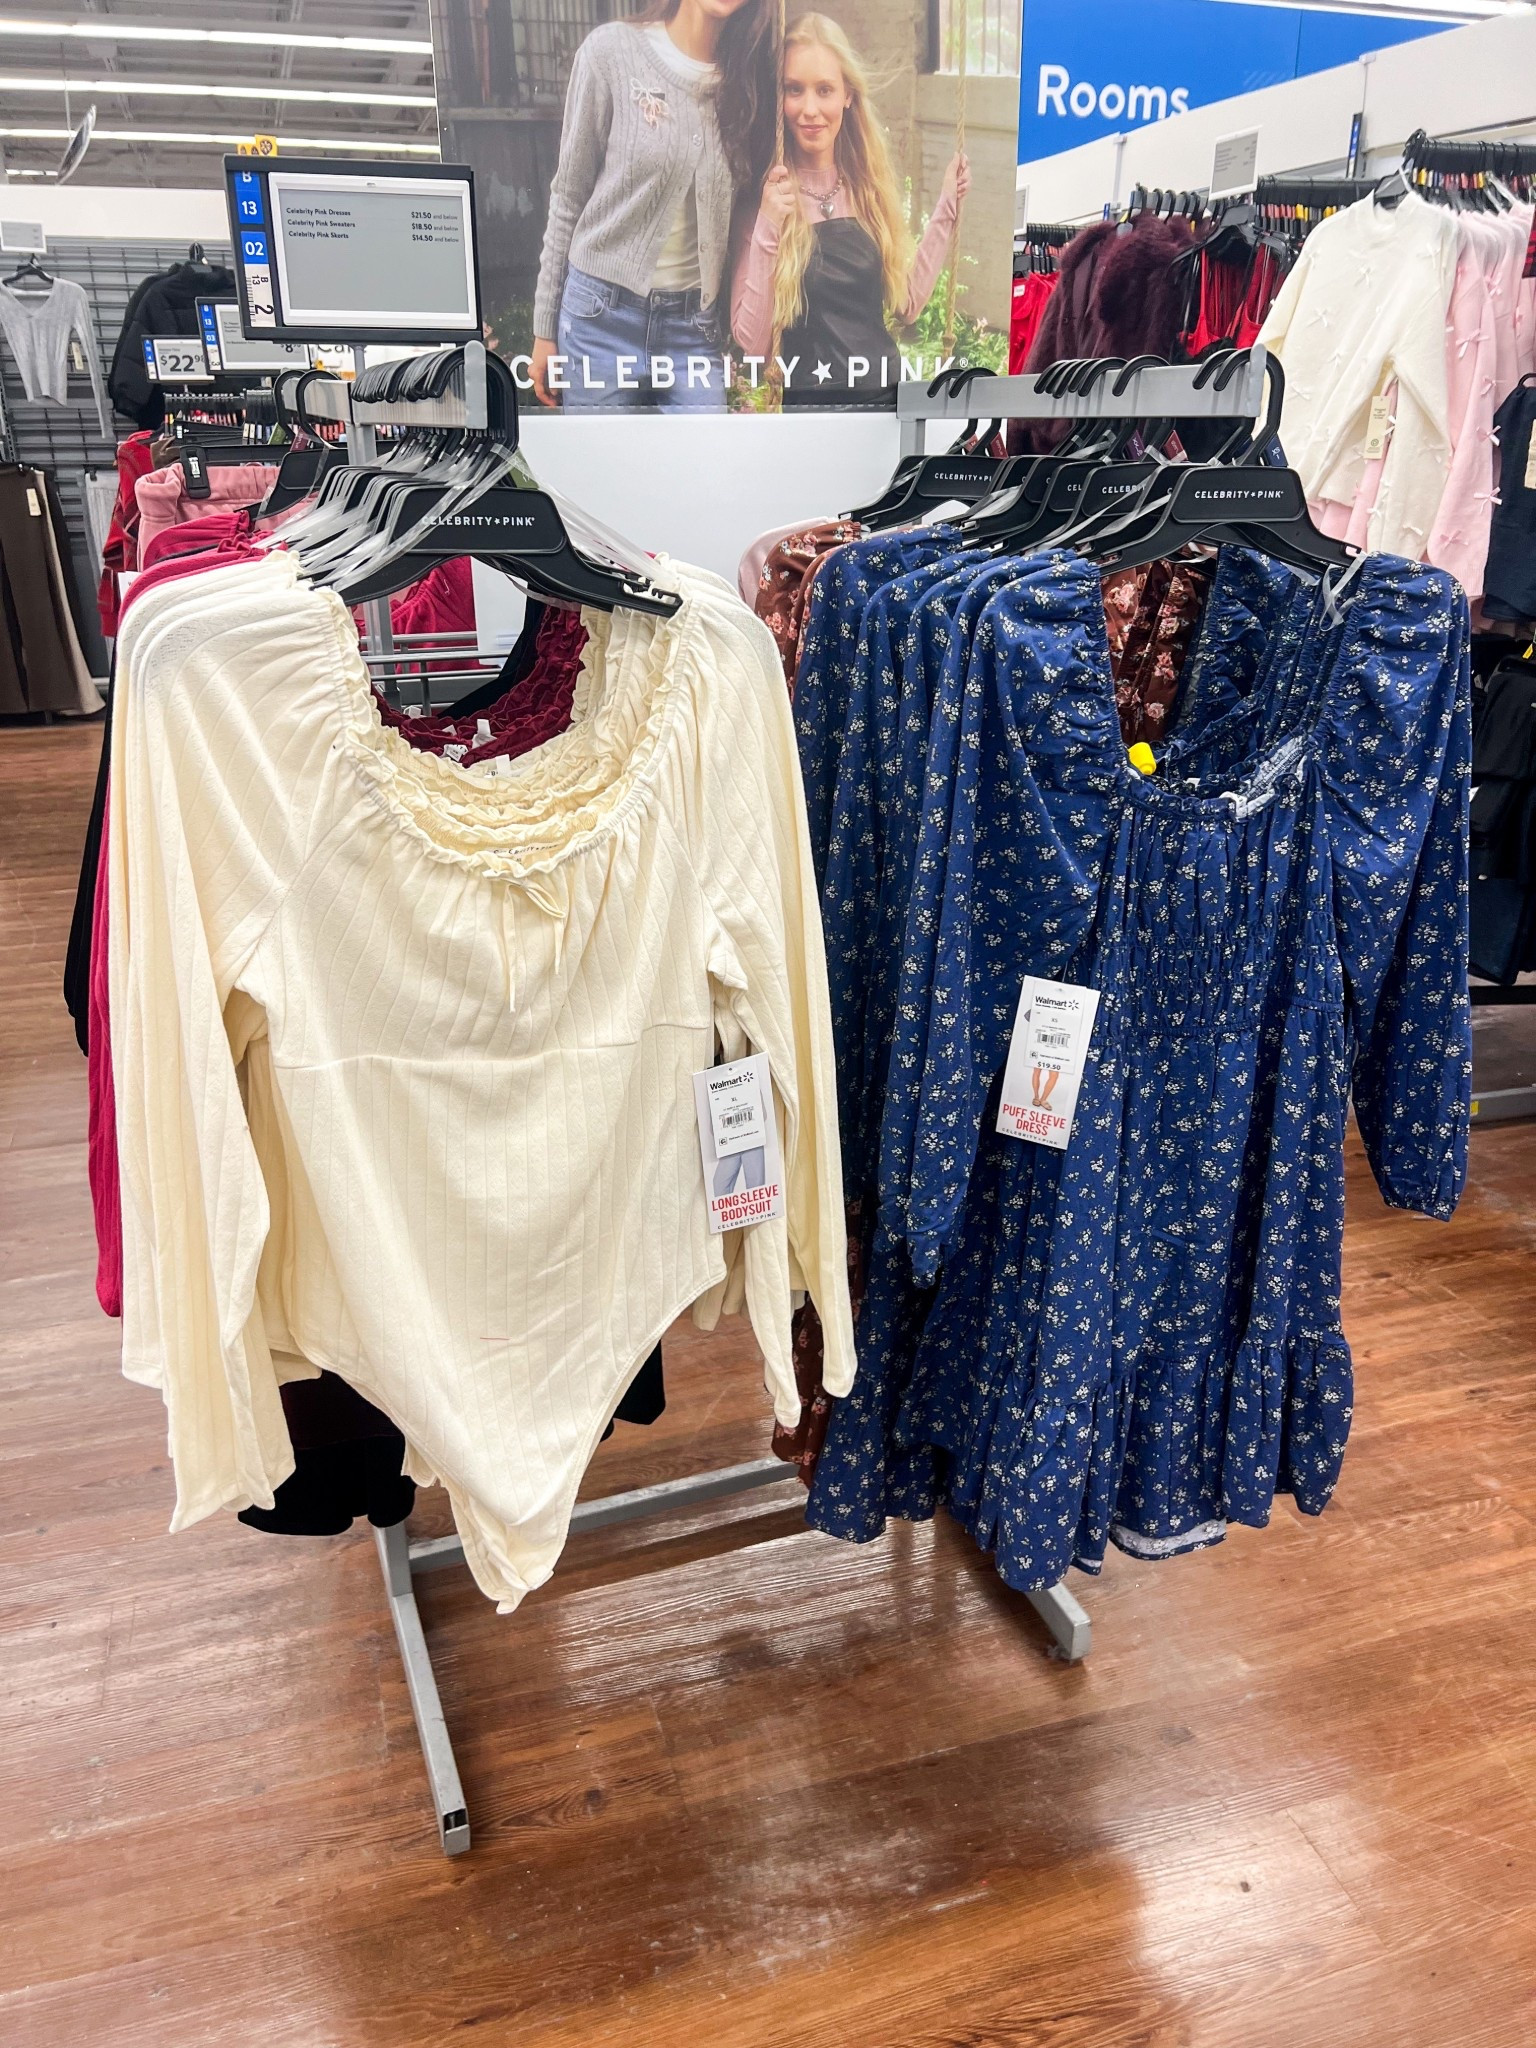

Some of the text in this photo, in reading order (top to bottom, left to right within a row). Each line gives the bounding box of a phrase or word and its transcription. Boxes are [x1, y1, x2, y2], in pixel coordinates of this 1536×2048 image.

[1037, 63, 1190, 120] Rooms
[241, 200, 258, 216] 13
[286, 207, 313, 216] Celebrity
[411, 211, 432, 219] $21.50
[287, 218, 356, 228] Celebrity Pink Sweaters
[412, 222, 433, 231] $18.50
[288, 230, 315, 240] Celebrity
[245, 241, 264, 256] 02
[254, 304, 275, 315] 2
[510, 354, 801, 390] CELEBRITY
[934, 472, 978, 482] CELEBRITY
[1194, 490, 1250, 499] CELEBRITY
[1035, 995, 1067, 1008] Walmart
[1037, 1060, 1061, 1071] $19.50
[709, 1075, 743, 1091] Walmart
[1002, 1103, 1067, 1130] PUFF SLEEVE
[1016, 1118, 1049, 1137] DRESS
[711, 1184, 779, 1212] LONG SLEEVE
[721, 1199, 772, 1222] BODYSUIT
